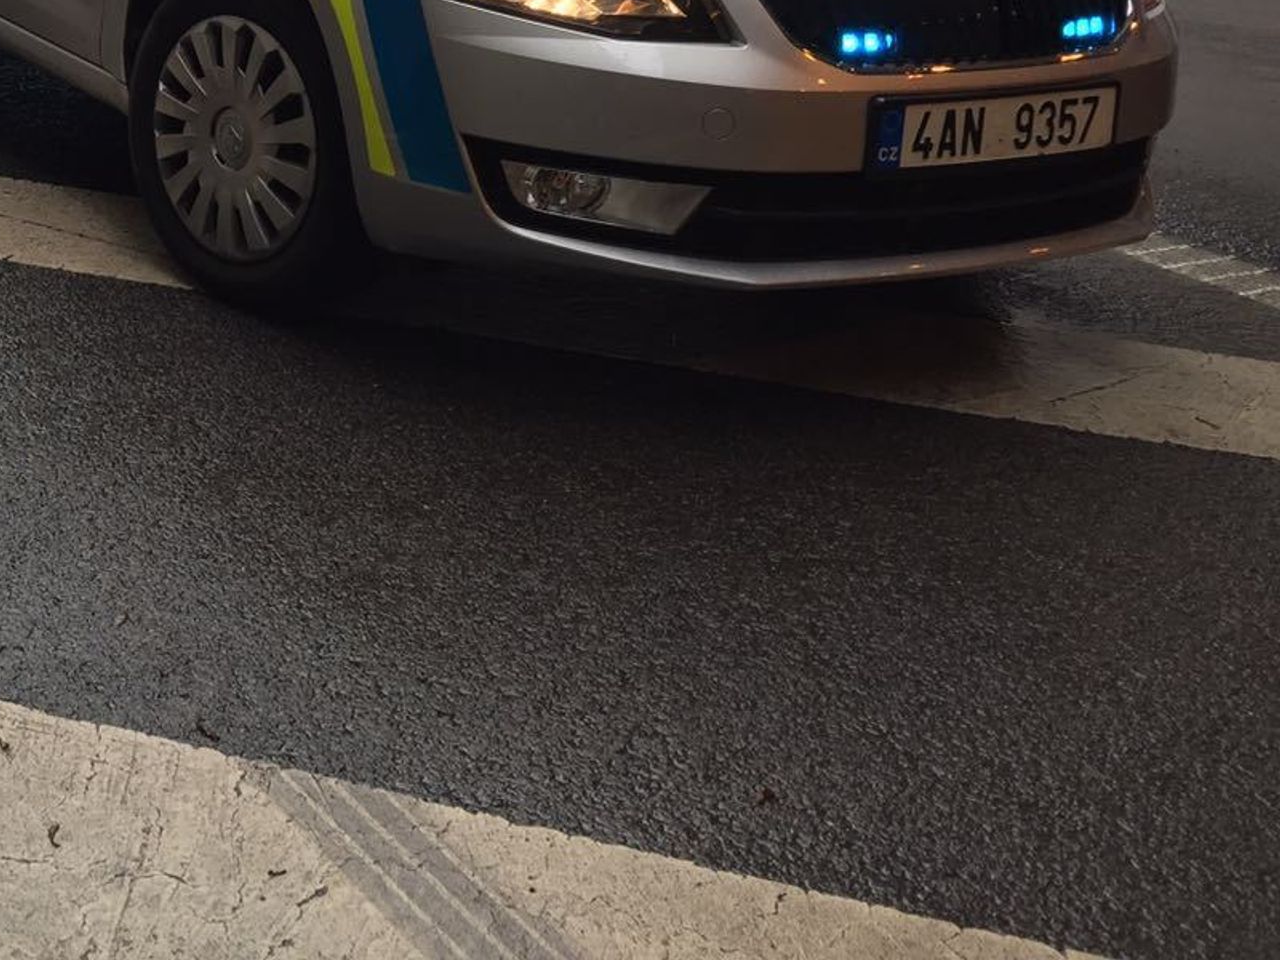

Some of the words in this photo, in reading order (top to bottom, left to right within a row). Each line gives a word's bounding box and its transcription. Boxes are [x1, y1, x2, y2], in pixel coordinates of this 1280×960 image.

[911, 106, 987, 160] 4AN
[1012, 95, 1100, 150] 9357
[878, 146, 898, 162] CZ
